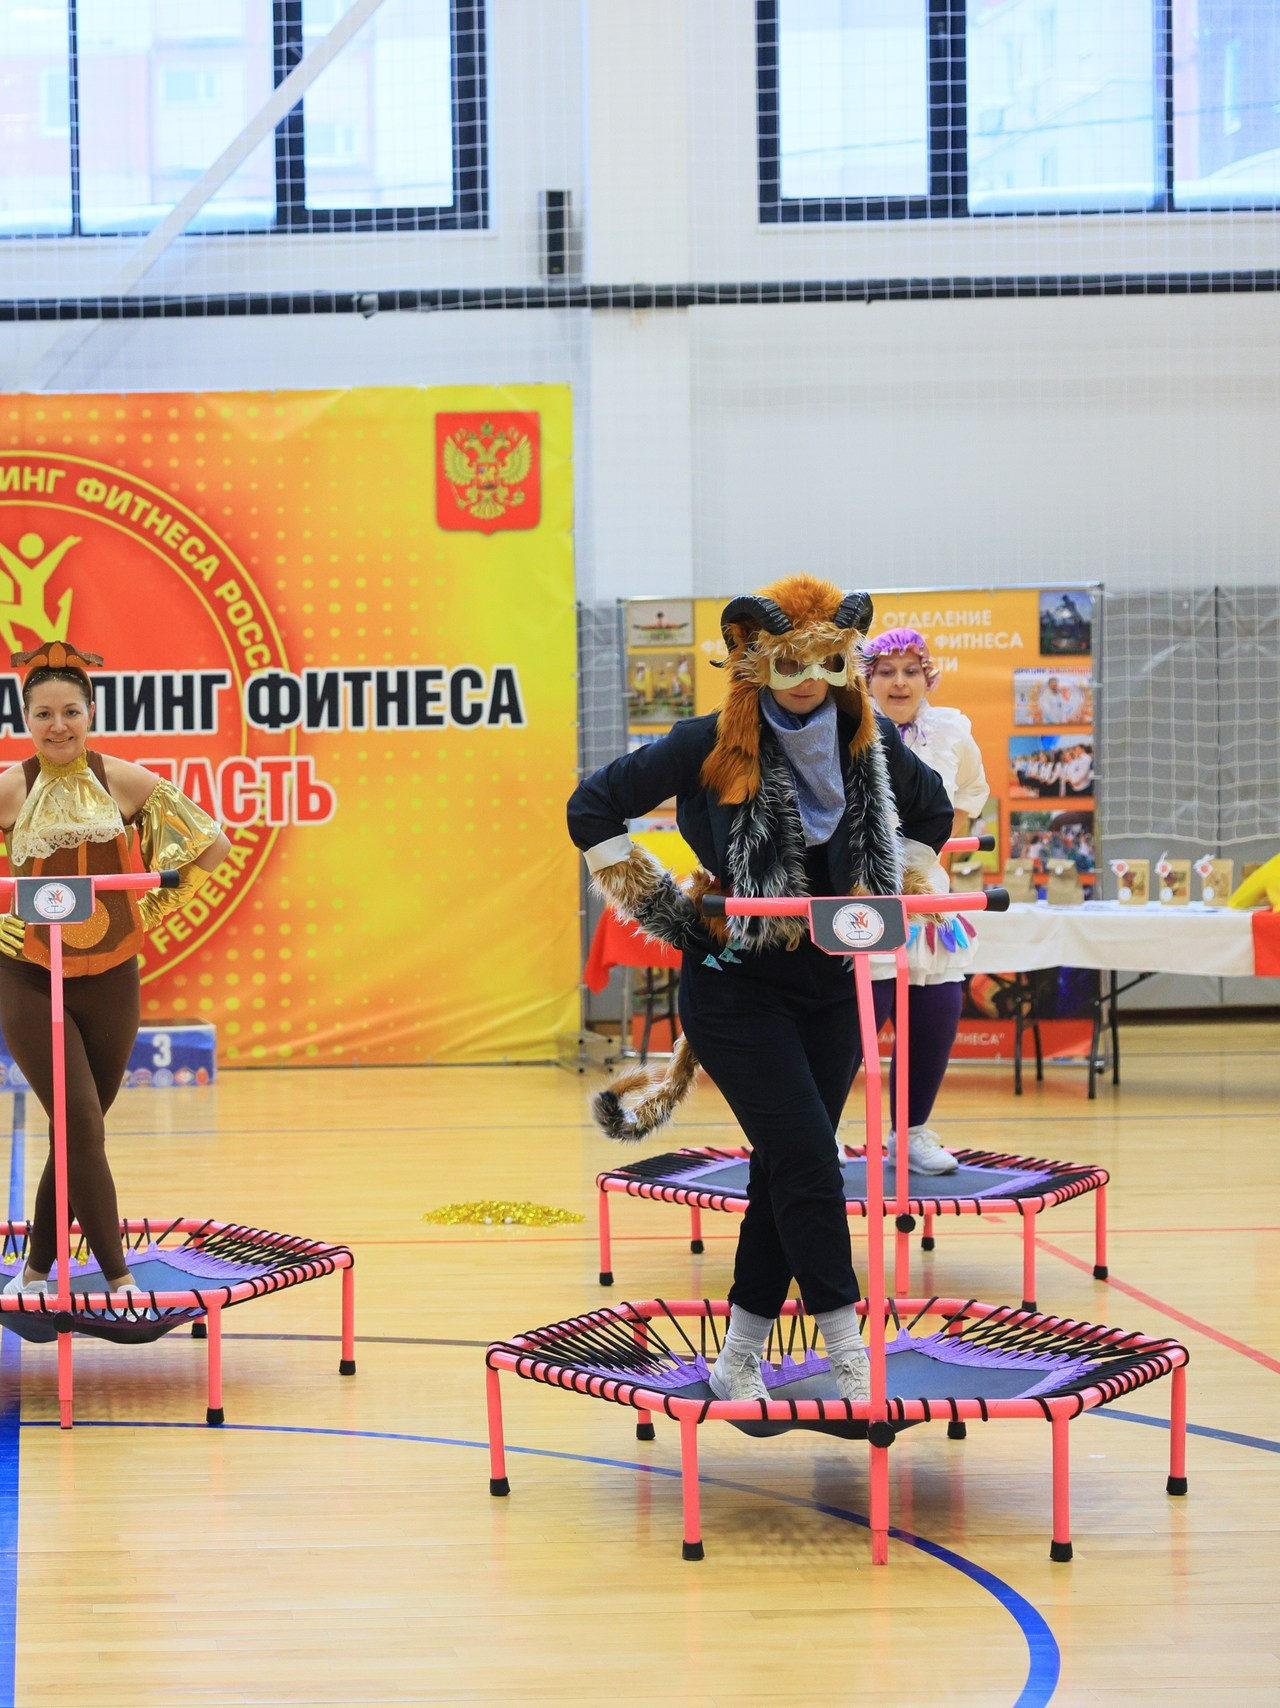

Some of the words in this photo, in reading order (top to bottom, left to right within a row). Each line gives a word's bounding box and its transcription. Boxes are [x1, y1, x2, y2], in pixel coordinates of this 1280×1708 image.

[76, 477, 220, 582] ФИТНЕСА
[214, 579, 274, 678] РОСС
[882, 609, 993, 629] ОТДЕЛЕНИЕ
[934, 631, 1024, 650] ФИТНЕСА
[246, 663, 526, 731] ФИТНЕСА
[135, 755, 336, 828] АСТЬ
[150, 826, 261, 955] FEDERAT
[152, 1034, 171, 1068] 3
